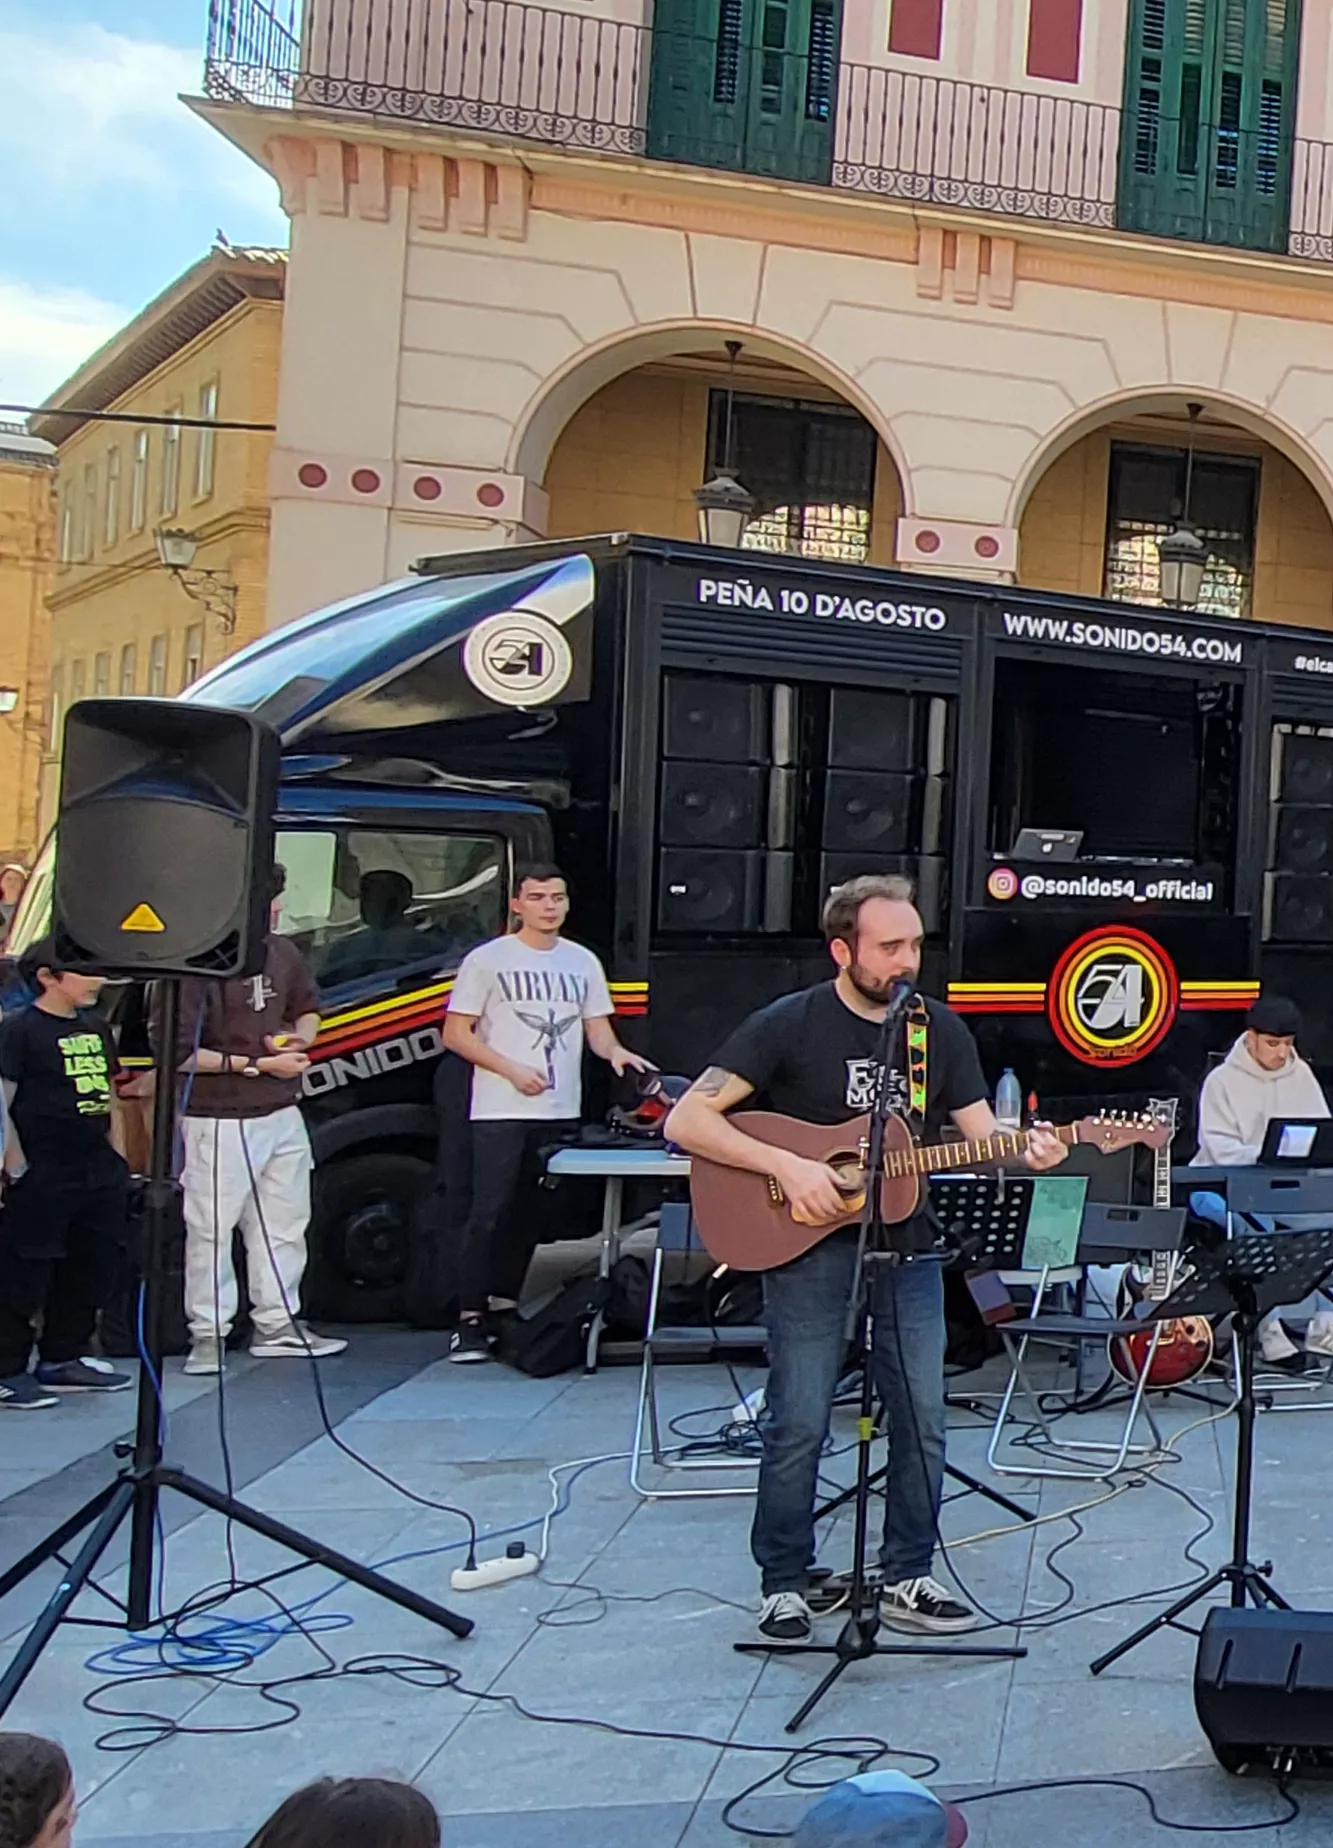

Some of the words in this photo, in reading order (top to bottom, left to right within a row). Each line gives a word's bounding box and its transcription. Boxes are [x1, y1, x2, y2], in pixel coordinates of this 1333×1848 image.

[698, 579, 774, 611] PEÑA
[781, 590, 809, 614] 10
[1003, 612, 1243, 664] WWW.SONIDO54.COM
[1021, 875, 1214, 902] @sonido54_official
[300, 1027, 445, 1097] ONIDO
